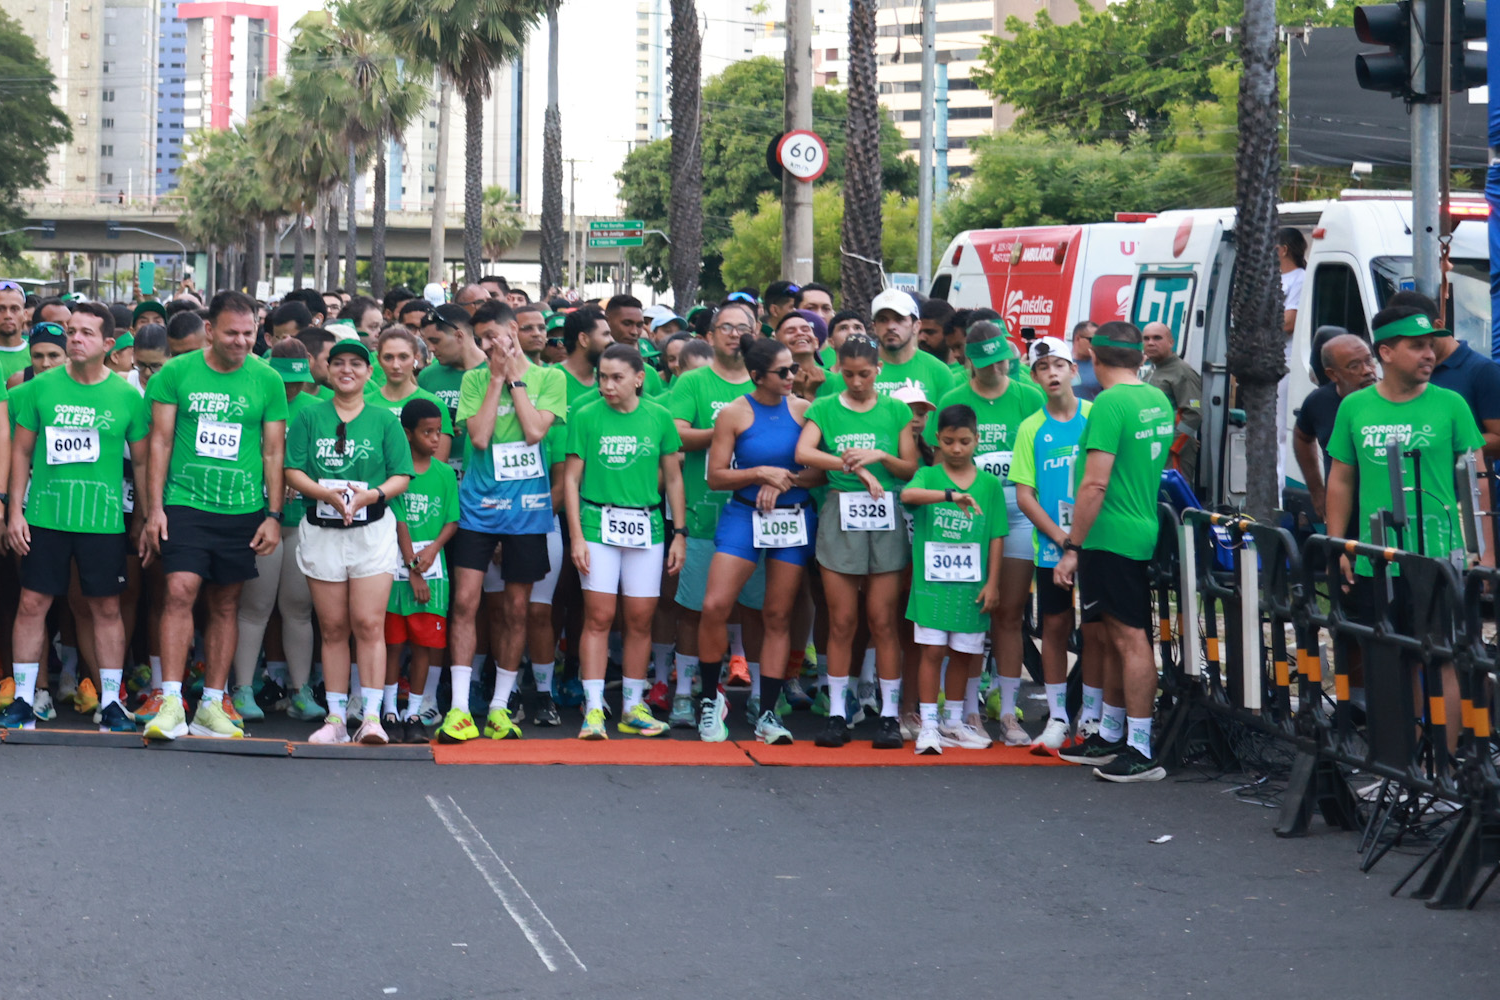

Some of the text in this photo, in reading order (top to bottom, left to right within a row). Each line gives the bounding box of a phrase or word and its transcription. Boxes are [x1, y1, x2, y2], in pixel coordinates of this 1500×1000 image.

[790, 142, 817, 163] 60
[790, 162, 809, 173] km/h
[1021, 295, 1053, 313] médica
[188, 392, 230, 402] CORRIDA
[54, 404, 96, 415] CORRIDA
[188, 401, 229, 413] ALEPI
[53, 413, 95, 427] ALEPI
[1361, 424, 1412, 436] CORRIDA
[55, 437, 92, 451] 6004
[200, 431, 237, 447] 6165
[600, 436, 637, 444] CORRIDA
[834, 433, 876, 444] CORRIDA
[978, 432, 1007, 443] LEPI
[599, 444, 636, 455] ALEPI
[502, 453, 536, 468] 1183
[984, 463, 1010, 476] 609
[849, 504, 887, 518] 5328
[609, 520, 644, 535] 5305
[761, 521, 798, 535] 1095
[933, 516, 973, 532] ALEPI
[942, 530, 961, 539] 2026
[933, 554, 972, 568] 3044
